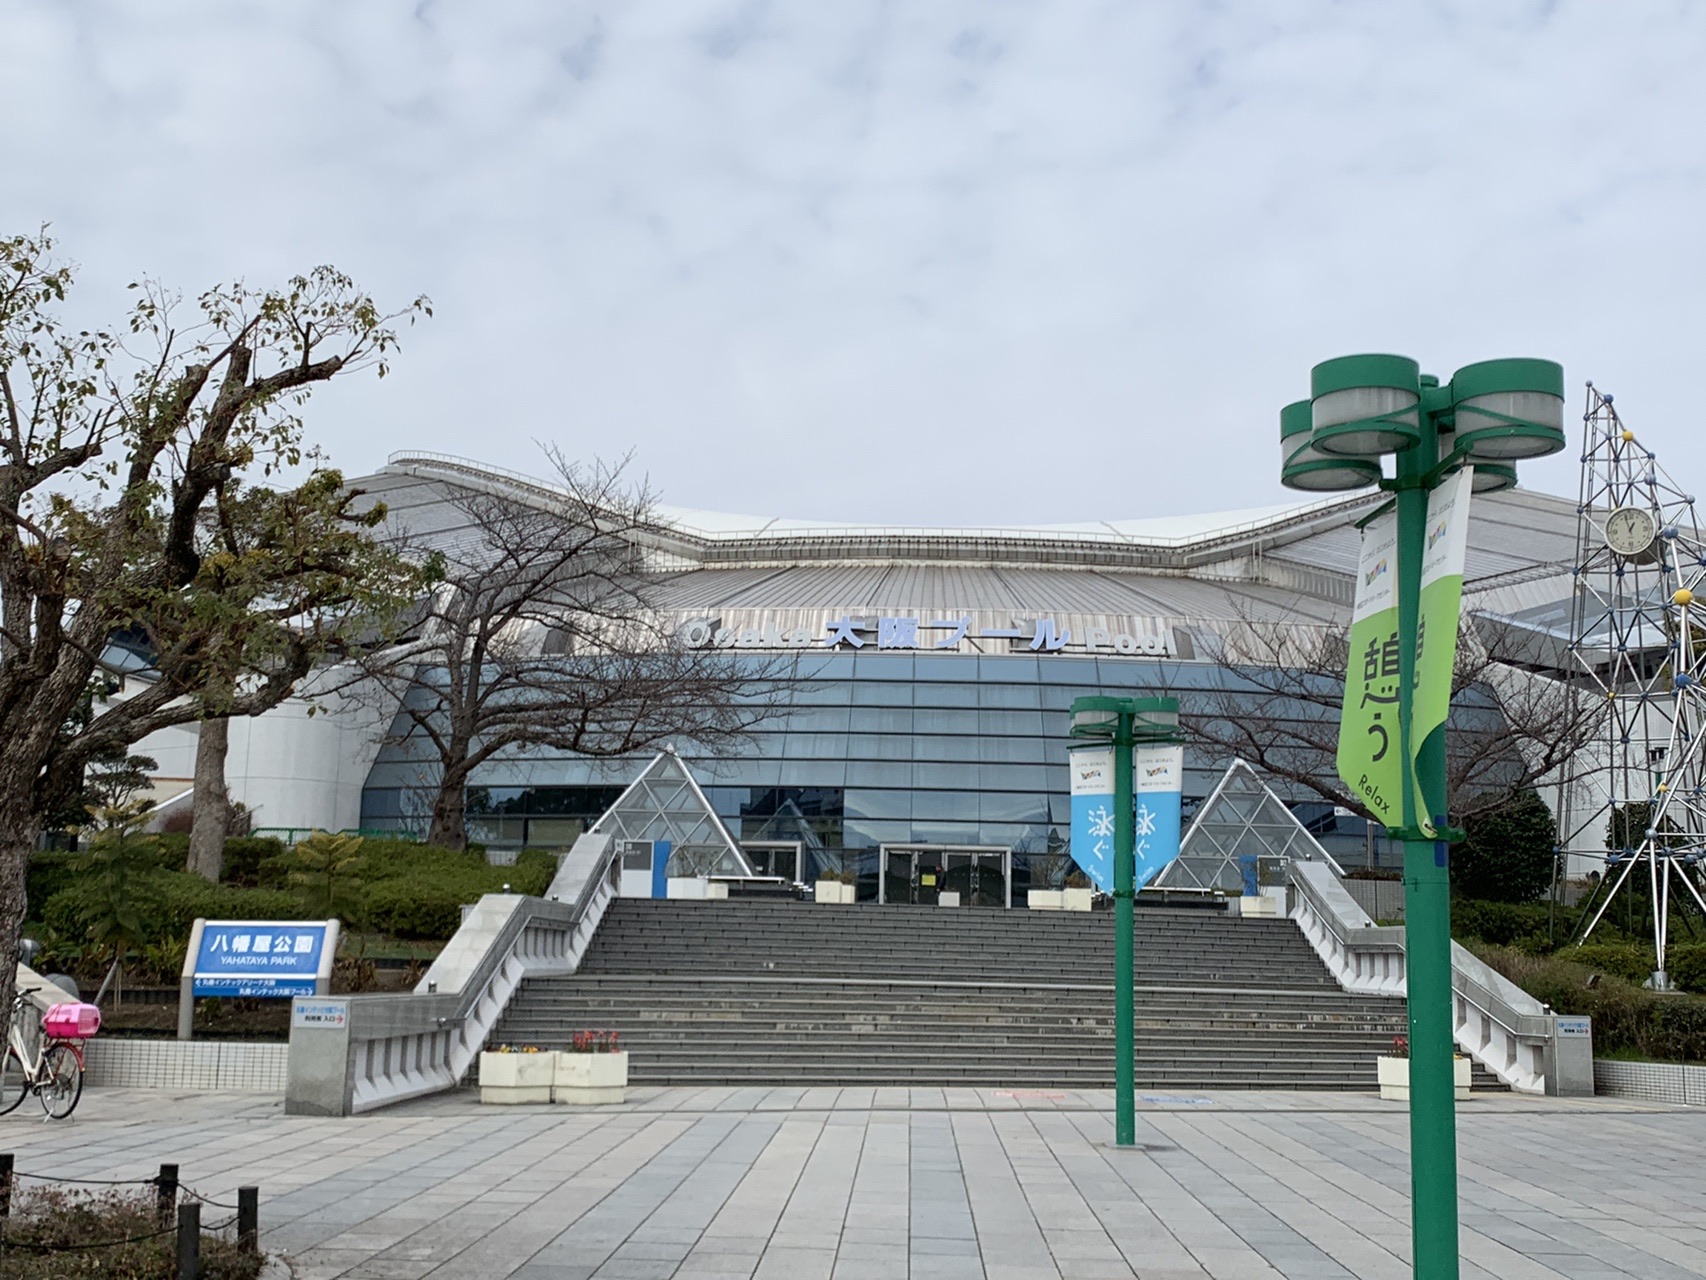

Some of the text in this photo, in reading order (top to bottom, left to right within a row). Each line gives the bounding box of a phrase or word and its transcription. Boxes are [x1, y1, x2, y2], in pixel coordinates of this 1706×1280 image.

[682, 620, 813, 649] Osaka
[825, 615, 1070, 650] 大阪プール
[1085, 626, 1178, 655] Pool
[1357, 773, 1391, 815] Relax
[1087, 864, 1105, 882] Swim
[1138, 865, 1154, 883] Swim
[210, 934, 314, 953] 八幡屋公園
[221, 956, 297, 965] YAHATAYA PARK
